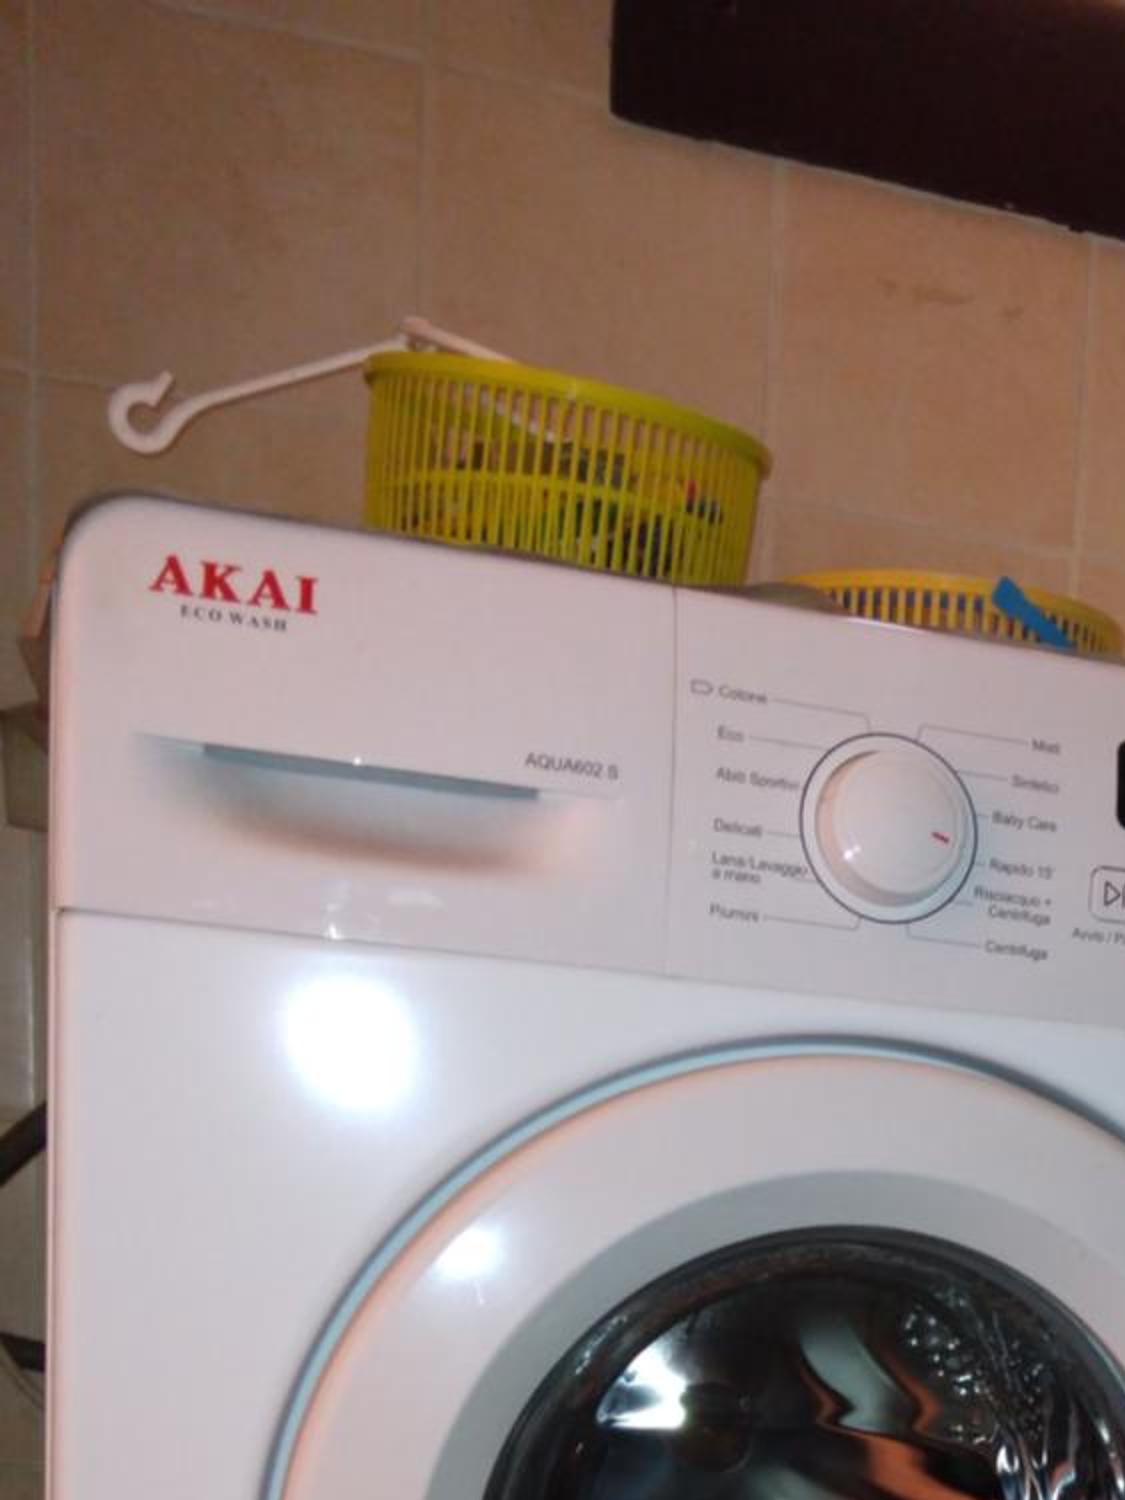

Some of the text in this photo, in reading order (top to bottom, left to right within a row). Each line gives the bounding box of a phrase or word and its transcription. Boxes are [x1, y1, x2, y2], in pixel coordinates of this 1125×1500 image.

[149, 553, 318, 615] AKAI
[180, 605, 288, 632] ECO WASH
[717, 724, 745, 742] Eco
[525, 752, 603, 778] AQUA602
[992, 811, 1057, 832] Baby Care
[723, 869, 761, 884] mano
[989, 856, 1034, 878] Rapido
[988, 904, 1051, 928] Centrifuga
[985, 940, 1048, 962] Centrifuga
